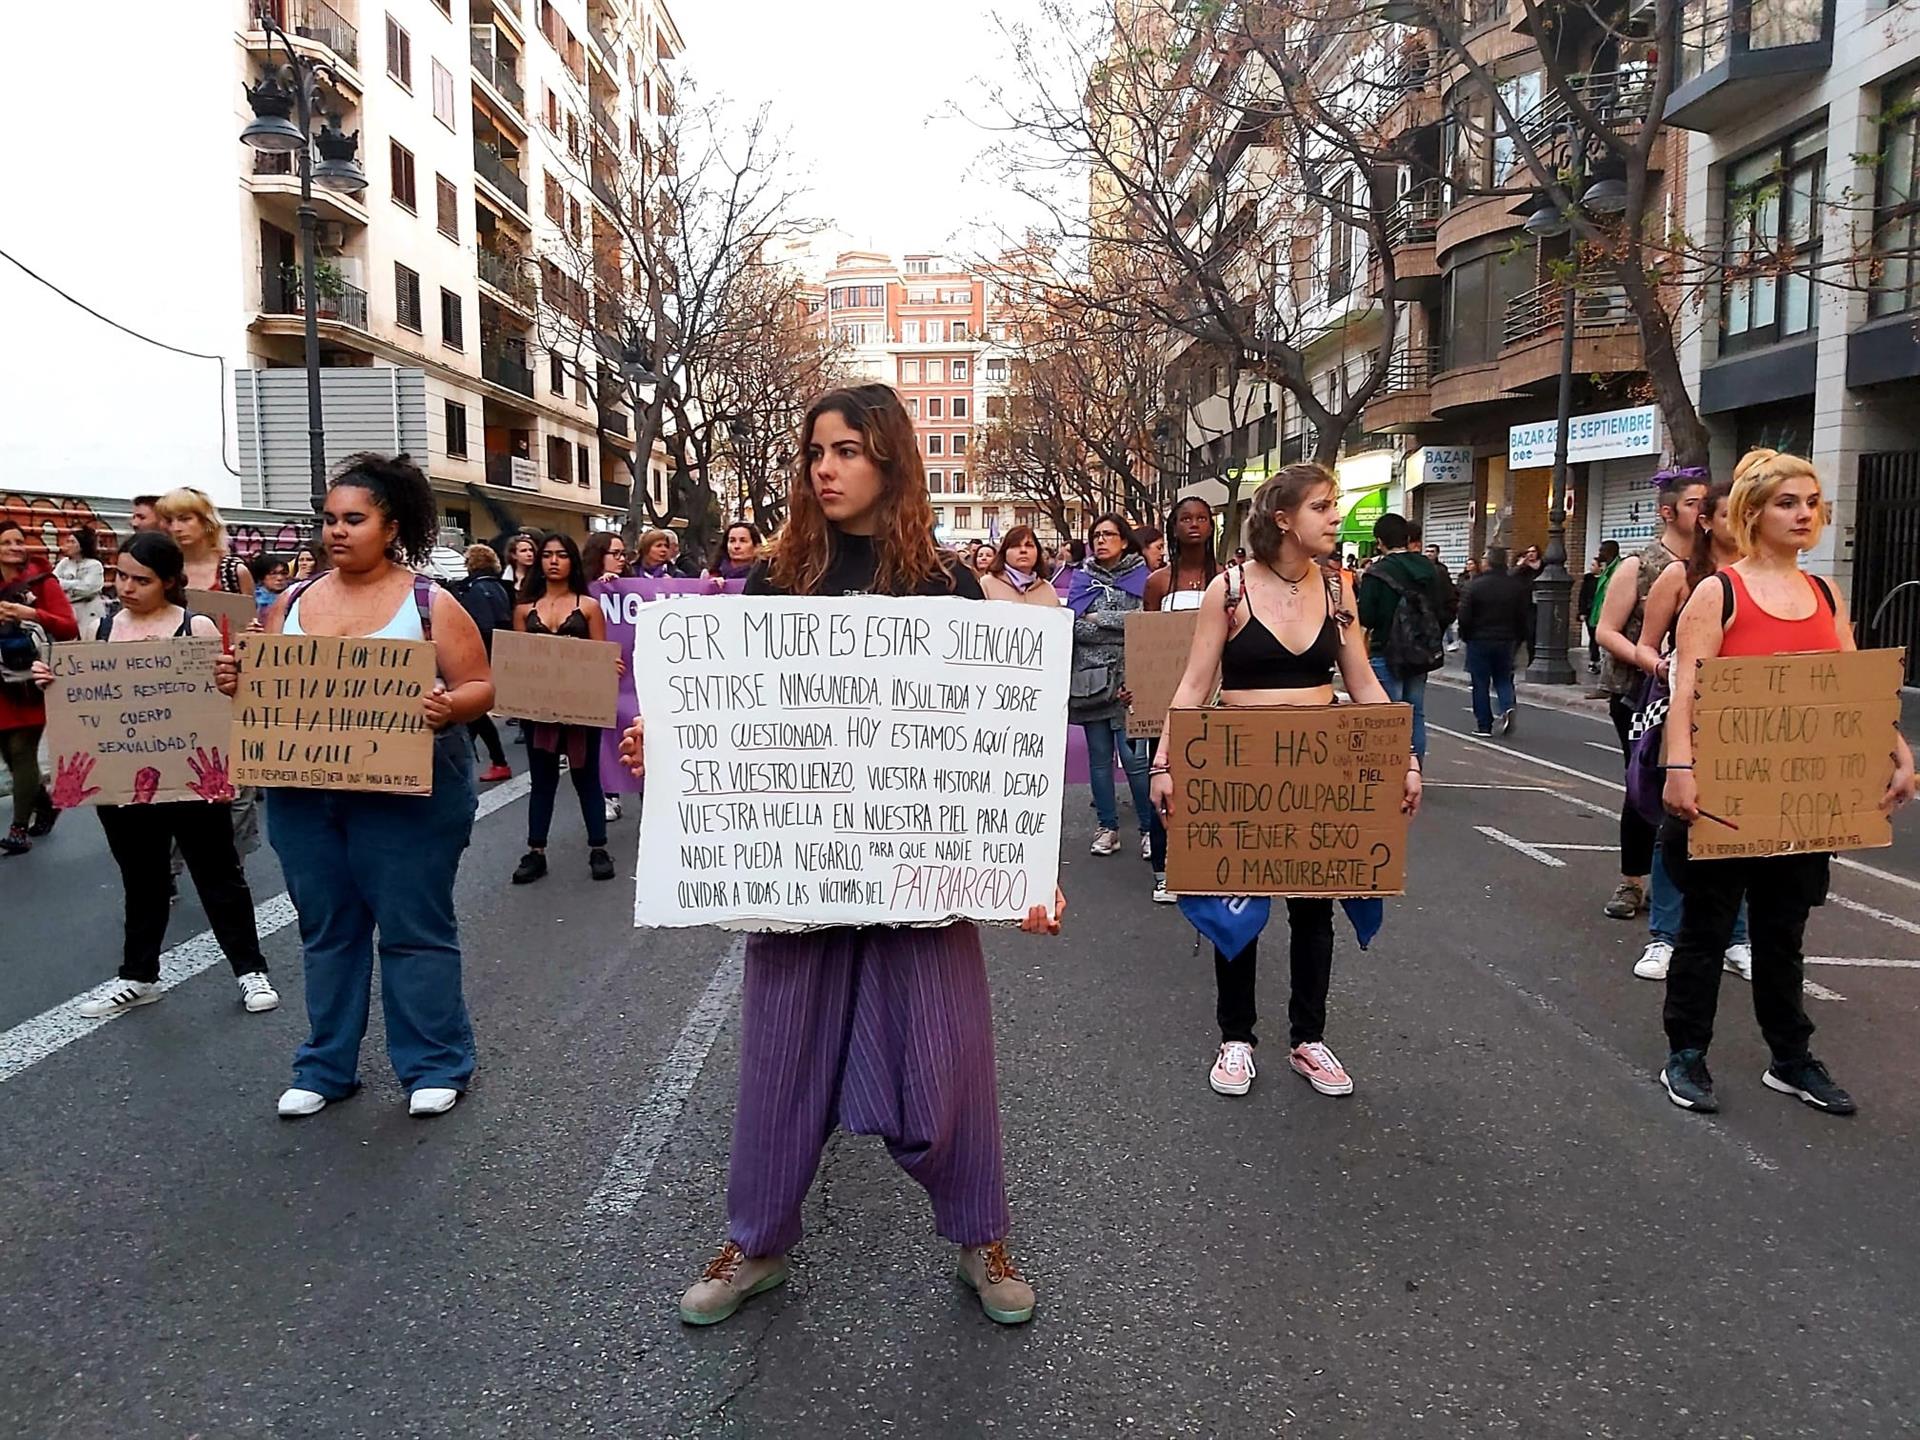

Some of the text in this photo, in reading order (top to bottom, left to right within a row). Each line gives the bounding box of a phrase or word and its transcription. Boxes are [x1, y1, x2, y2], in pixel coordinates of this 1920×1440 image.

[1511, 429, 1544, 448] BAZAR
[1581, 413, 1653, 438] SEPTIEMBRE
[1425, 450, 1470, 464] BAZAR
[600, 592, 642, 625] NO
[659, 611, 1043, 666] SER MUJER ES ESTAR SILENCIADA
[53, 655, 171, 677] ¿SE HAN HECHO
[337, 641, 414, 670] HOMBRE
[67, 681, 215, 703] BROMAS RESPECTO A
[273, 679, 293, 699] TE
[300, 678, 318, 699] HA
[326, 678, 421, 699] INSINUADO
[669, 673, 767, 714] SENTIRSE
[976, 685, 987, 710] Y
[993, 684, 1042, 712] SOBRE
[1711, 664, 1840, 694] ¿SE TE HA
[79, 707, 172, 728] TU CUERPO
[127, 727, 136, 738] O
[242, 705, 425, 734] O TE HA PIROPEADO
[1718, 705, 1864, 745] CRITICADO POR
[242, 739, 264, 762] POR
[278, 740, 296, 762] LA
[673, 715, 1044, 758] TODO CUESTIONADA. HOY ESTAMOS AQUÍ PARA
[1185, 713, 1328, 769] ¿TE HAS
[681, 759, 721, 793] SER
[728, 761, 798, 792] VUESTRO
[867, 765, 927, 791] VUESTRA
[1004, 771, 1049, 798] DEJAD
[1715, 753, 1867, 783] LLEVAR CIERTO TIPO
[1187, 779, 1378, 814] SENTIDO CULPABLE
[678, 801, 1047, 836] VUESTRA HUELLA EN NUESTRA PIEL PARA QUE
[1724, 789, 1864, 838] DE ROPA?
[1187, 821, 1359, 850] POR TENER SEXO
[681, 844, 727, 870] NADIE
[734, 841, 782, 870] PUEDA
[795, 841, 863, 872] NEGARLO.
[869, 841, 894, 858] PARA
[899, 842, 927, 860] QUE
[983, 842, 1024, 864] PUEDA
[1216, 843, 1391, 890] O MASTURBARTE?
[678, 863, 1028, 913] OLVIDAR A TODAS LAS VÍCTIMAS DEL PATRIARCADO
